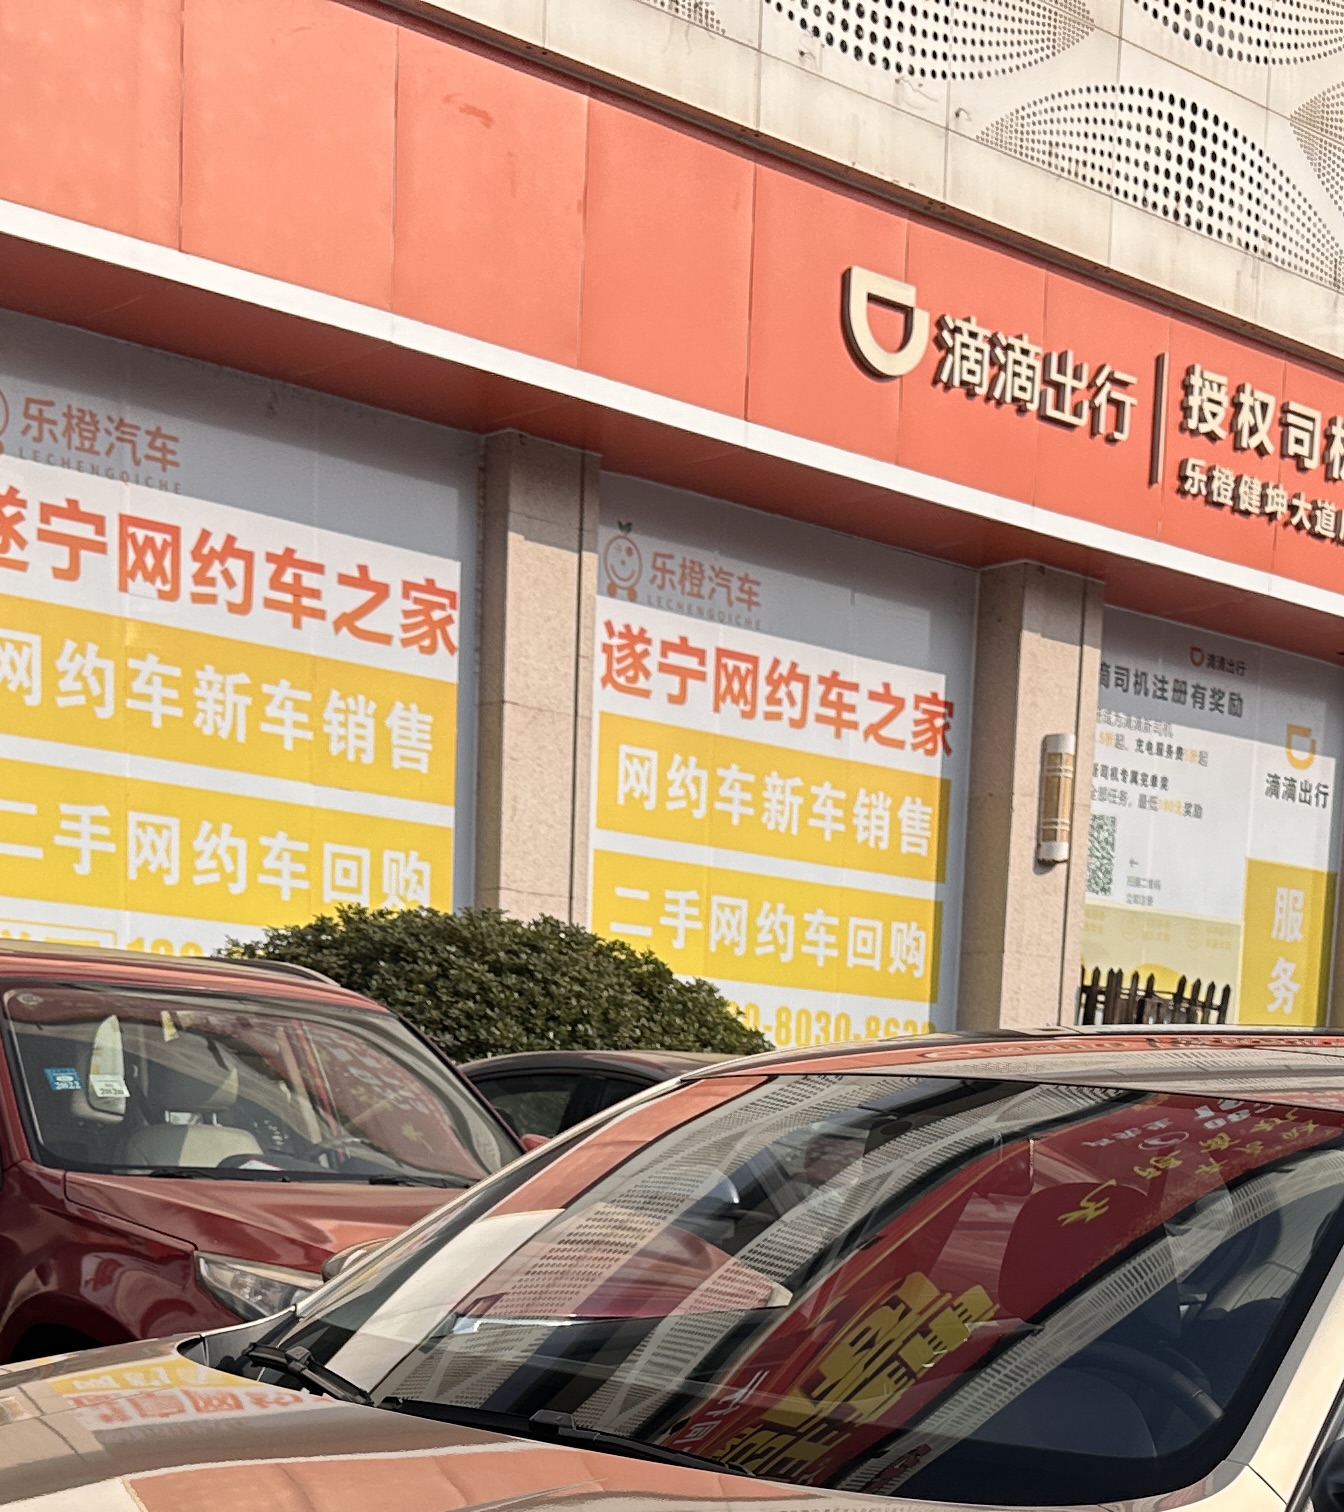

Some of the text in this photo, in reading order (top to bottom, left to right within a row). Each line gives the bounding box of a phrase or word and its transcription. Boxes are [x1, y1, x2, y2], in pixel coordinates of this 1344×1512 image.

[933, 314, 1138, 444] 滴滴出行
[18, 447, 182, 495] LECHENGQICHE
[21, 397, 181, 473] 乐橙汽车
[648, 551, 762, 612] 乐橙汽车
[601, 620, 954, 758] 遂宁网约车之家
[616, 743, 933, 857] 网约车新车销售
[1265, 772, 1329, 809] 滴滴出行
[609, 886, 928, 979] 二手网约车回购
[1266, 886, 1306, 1015] 服务
